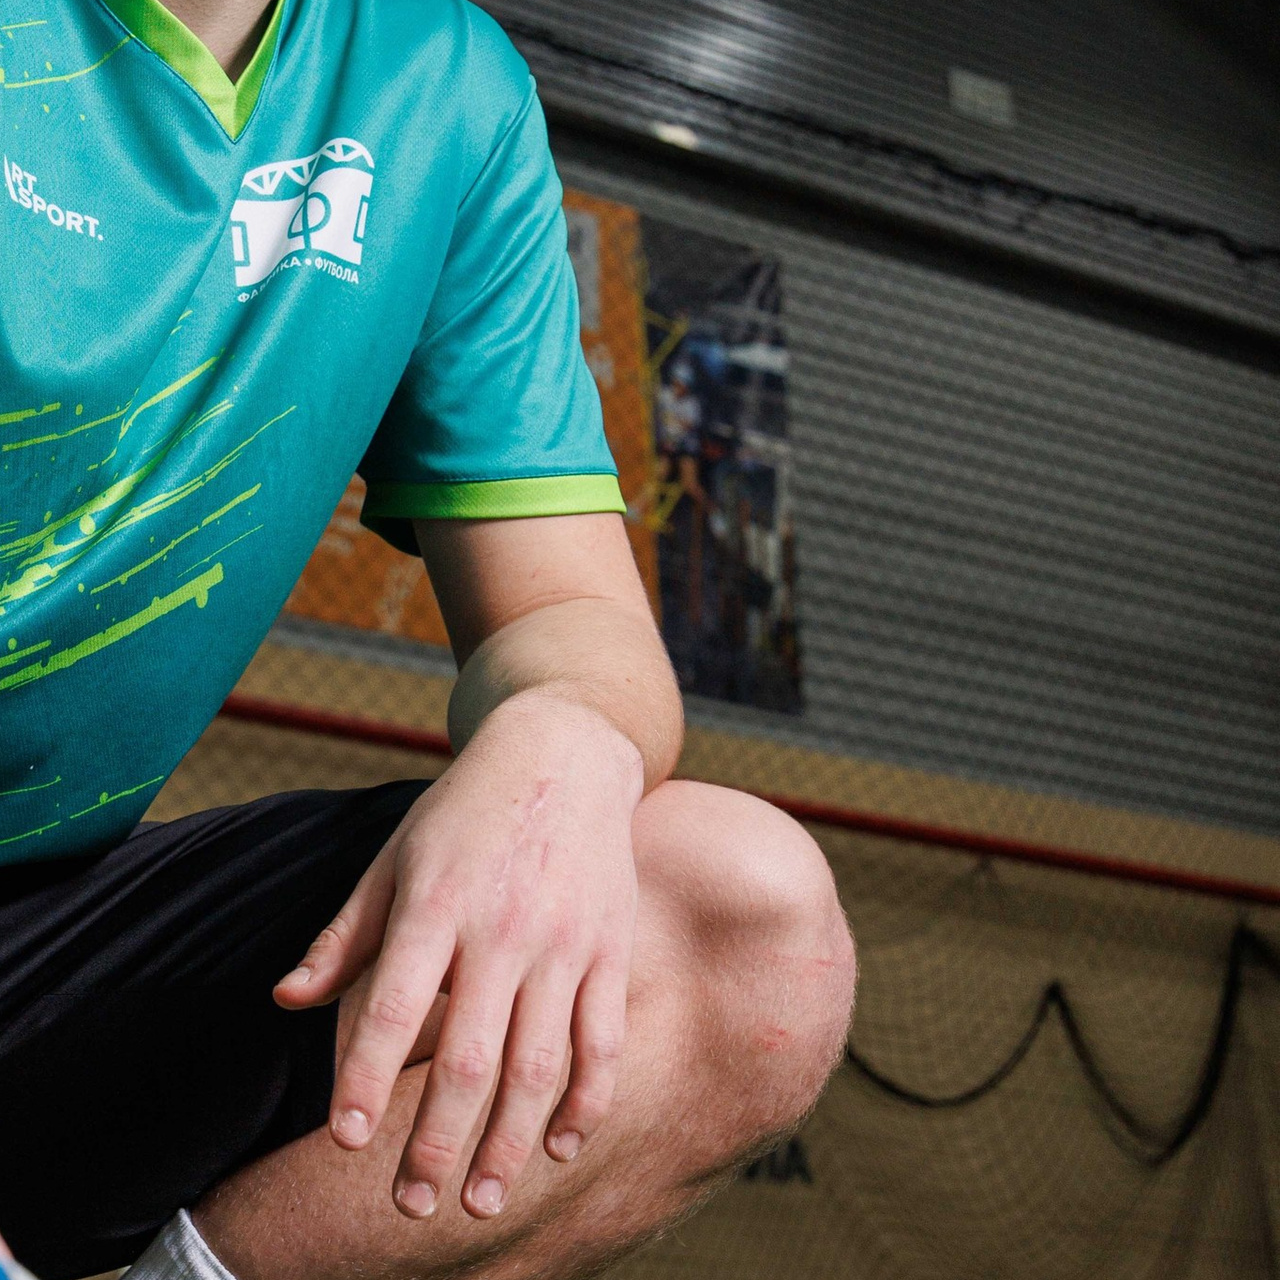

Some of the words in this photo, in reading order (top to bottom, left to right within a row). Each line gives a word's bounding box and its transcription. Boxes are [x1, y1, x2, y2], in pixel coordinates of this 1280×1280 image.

[18, 187, 104, 241] SPORT.
[237, 257, 302, 303] ФАКА
[314, 257, 359, 284] ФУТБОЛА
